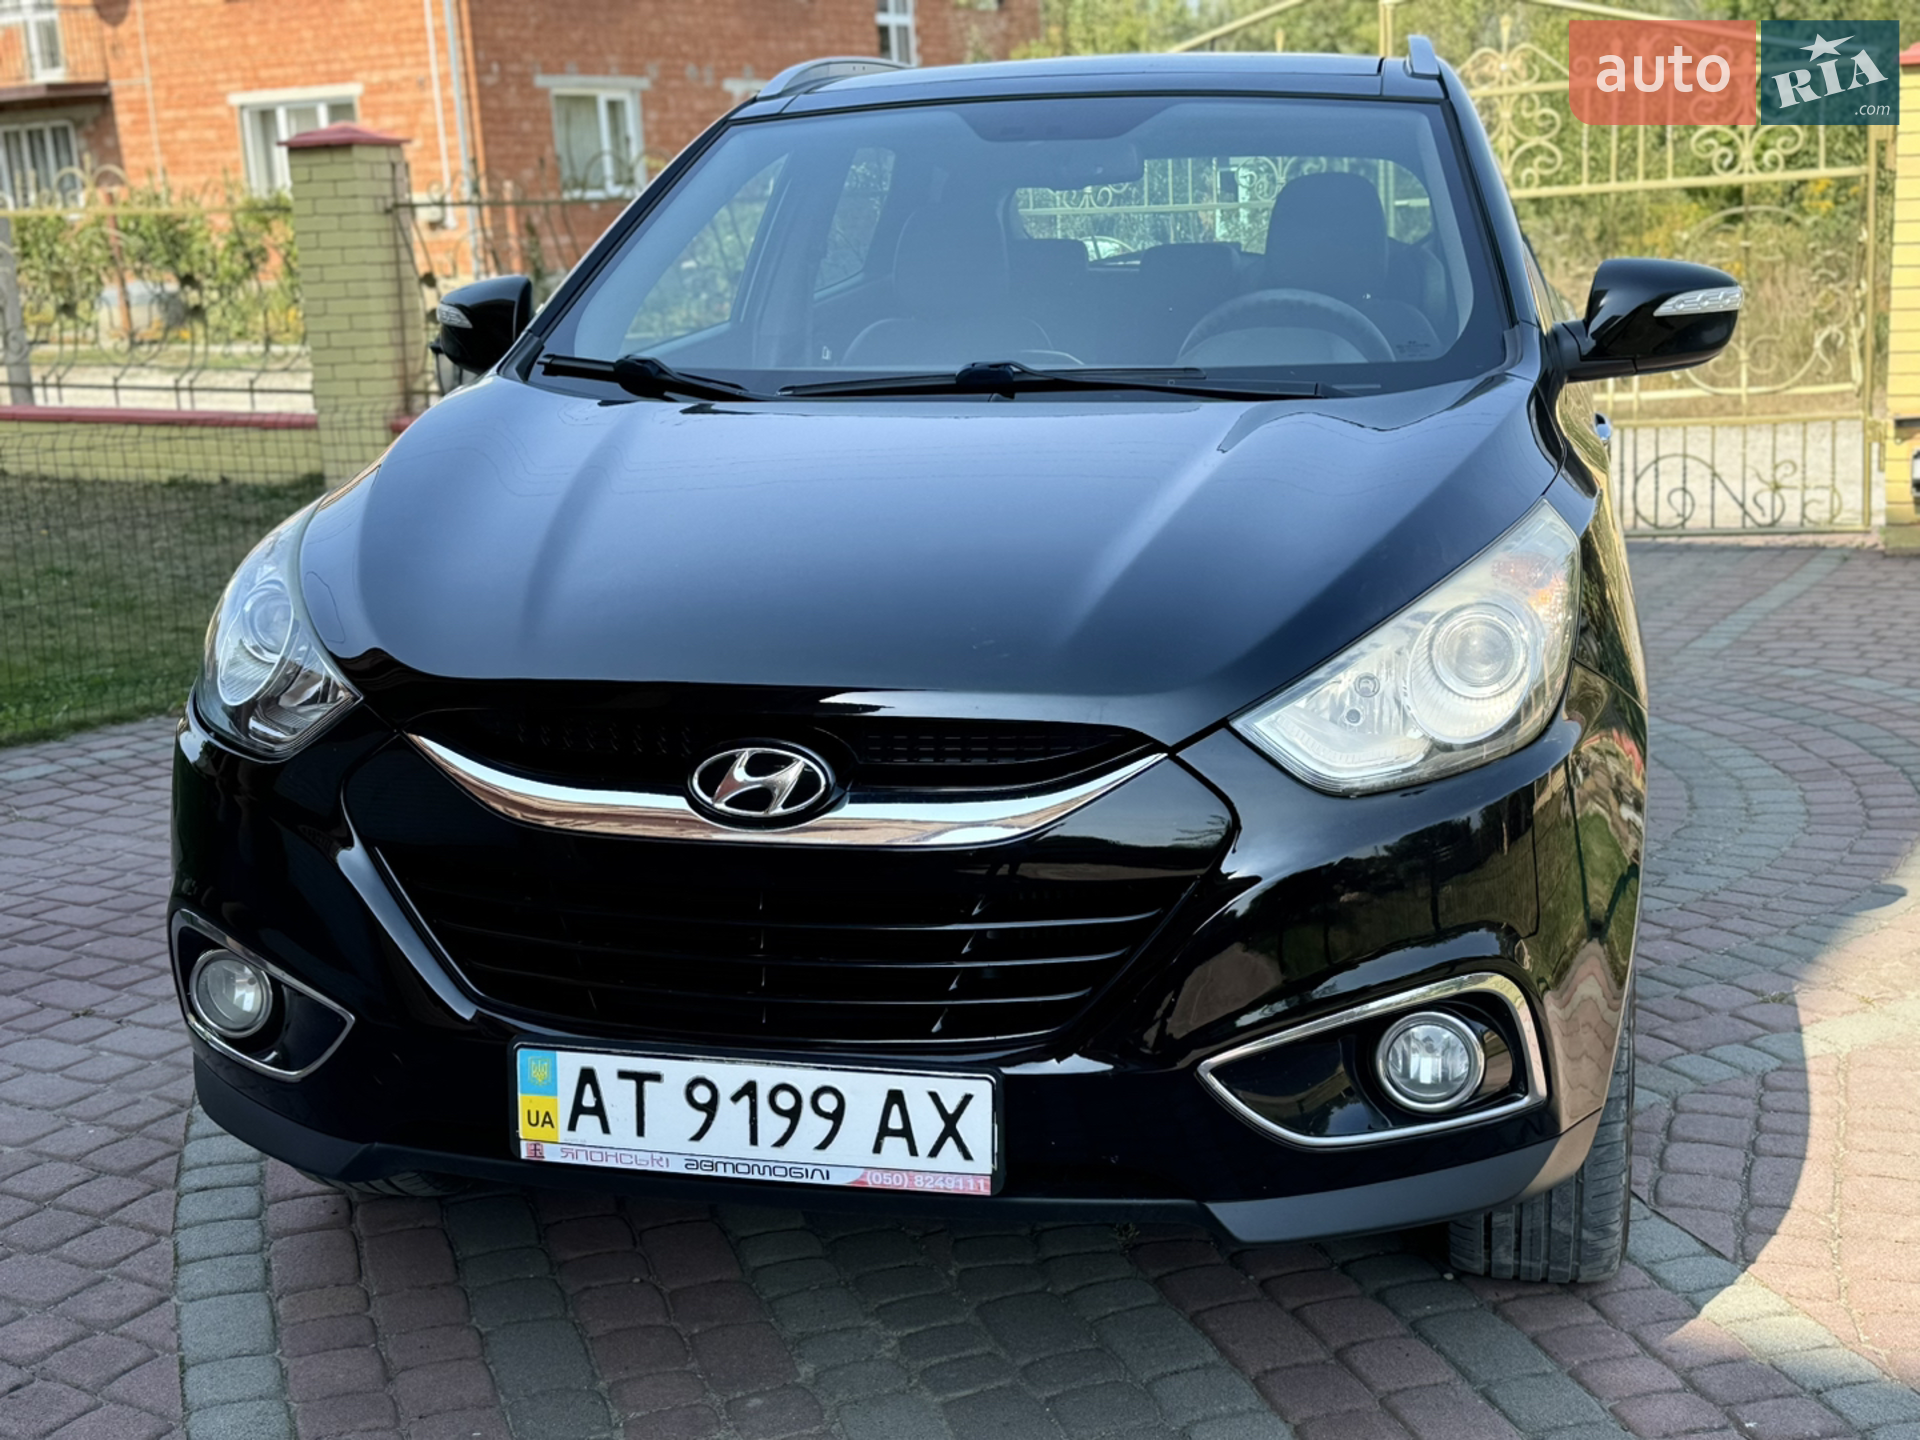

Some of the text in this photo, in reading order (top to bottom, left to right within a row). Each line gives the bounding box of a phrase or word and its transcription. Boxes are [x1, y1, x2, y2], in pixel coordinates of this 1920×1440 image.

[527, 1109, 555, 1129] UA
[566, 1067, 975, 1161] AT 9199 AX
[866, 1170, 909, 1188] (050)
[914, 1174, 985, 1192] 8249111
